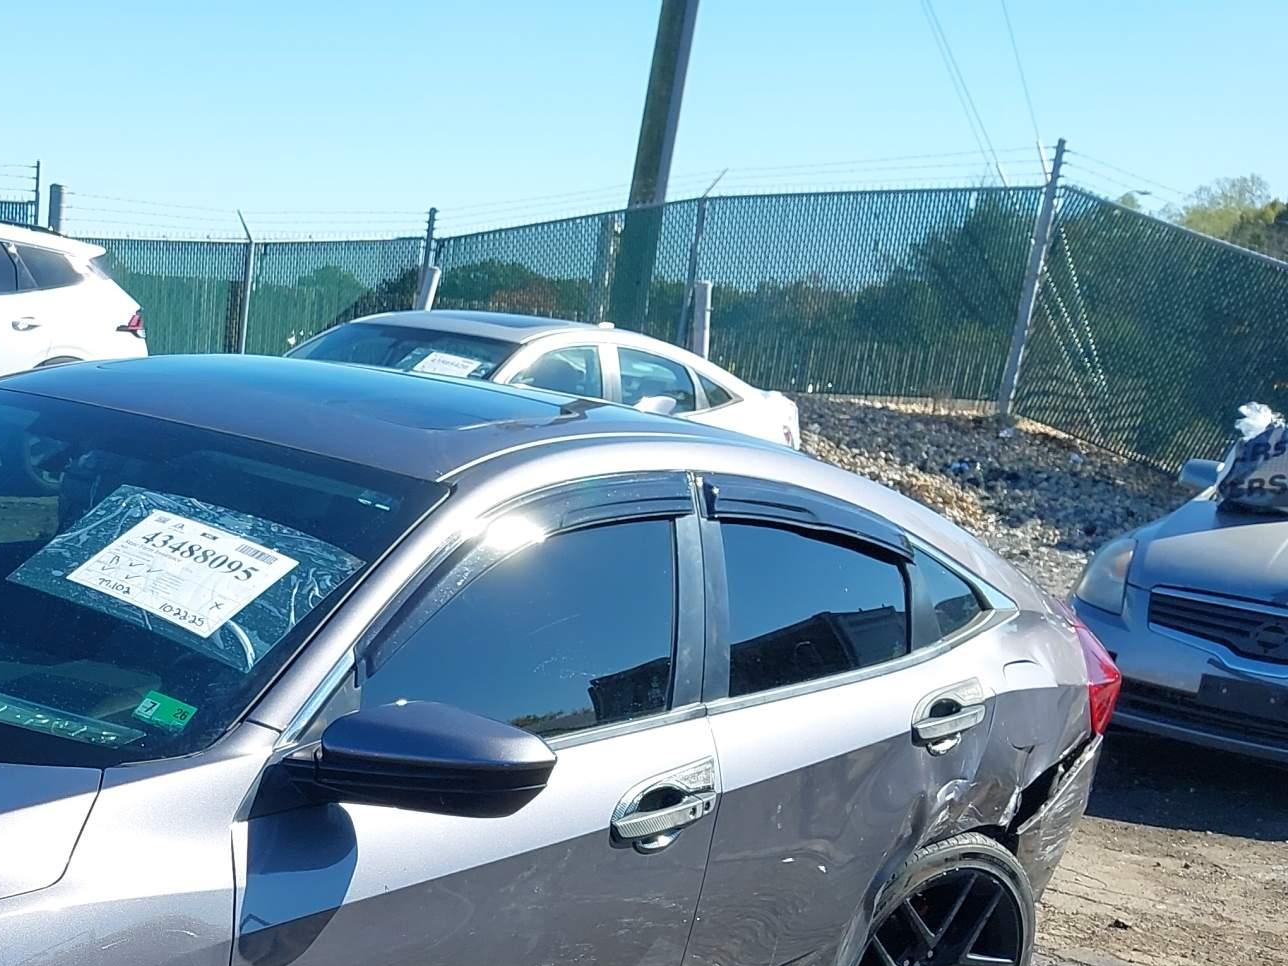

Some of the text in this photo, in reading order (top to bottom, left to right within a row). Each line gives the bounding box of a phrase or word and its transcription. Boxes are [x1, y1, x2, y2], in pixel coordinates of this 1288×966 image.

[141, 531, 260, 581] 43488095
[144, 700, 190, 721] 7 26
